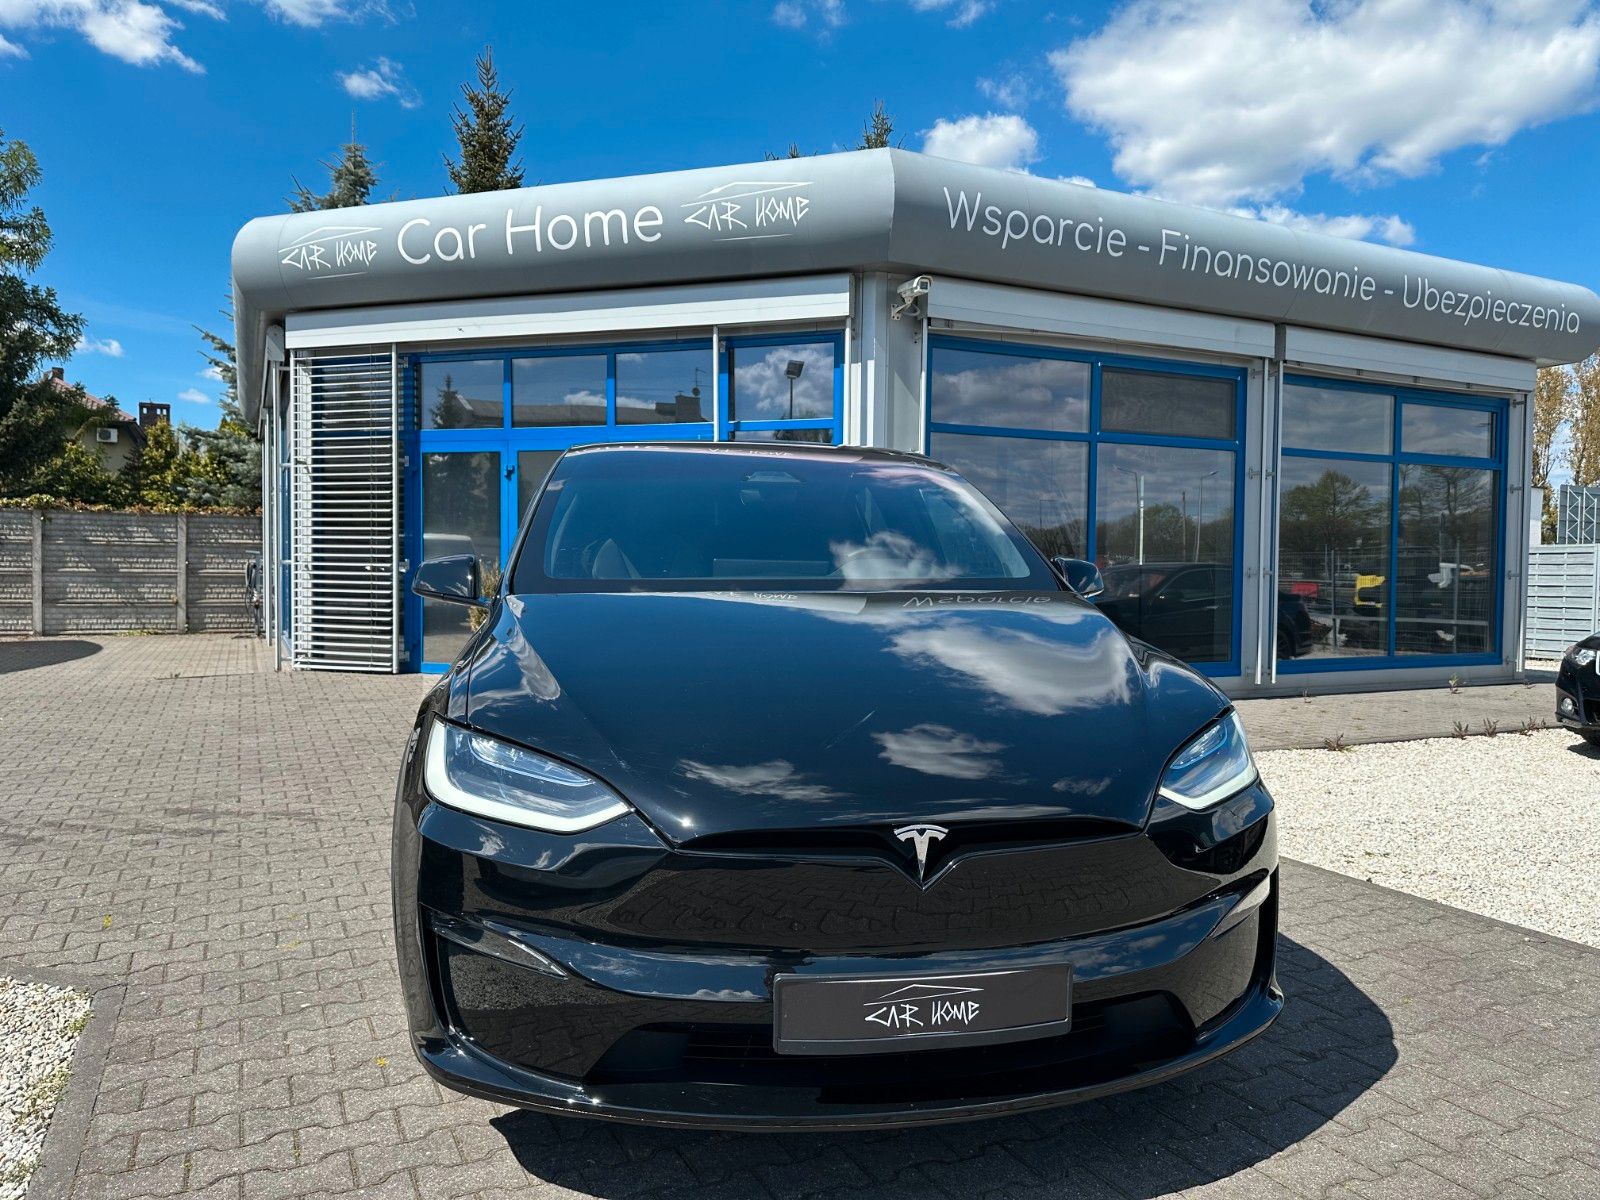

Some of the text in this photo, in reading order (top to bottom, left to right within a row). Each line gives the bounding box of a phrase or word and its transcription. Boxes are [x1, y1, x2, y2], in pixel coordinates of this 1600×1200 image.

[683, 201, 748, 232] CAR
[397, 205, 664, 265] Car Home
[280, 244, 332, 271] CAR
[944, 187, 1127, 257] Wsparcie
[1159, 229, 1376, 301] Finansowanie
[1403, 274, 1580, 334] Ubezpieczenia
[864, 1000, 980, 1028] CAR HOME
